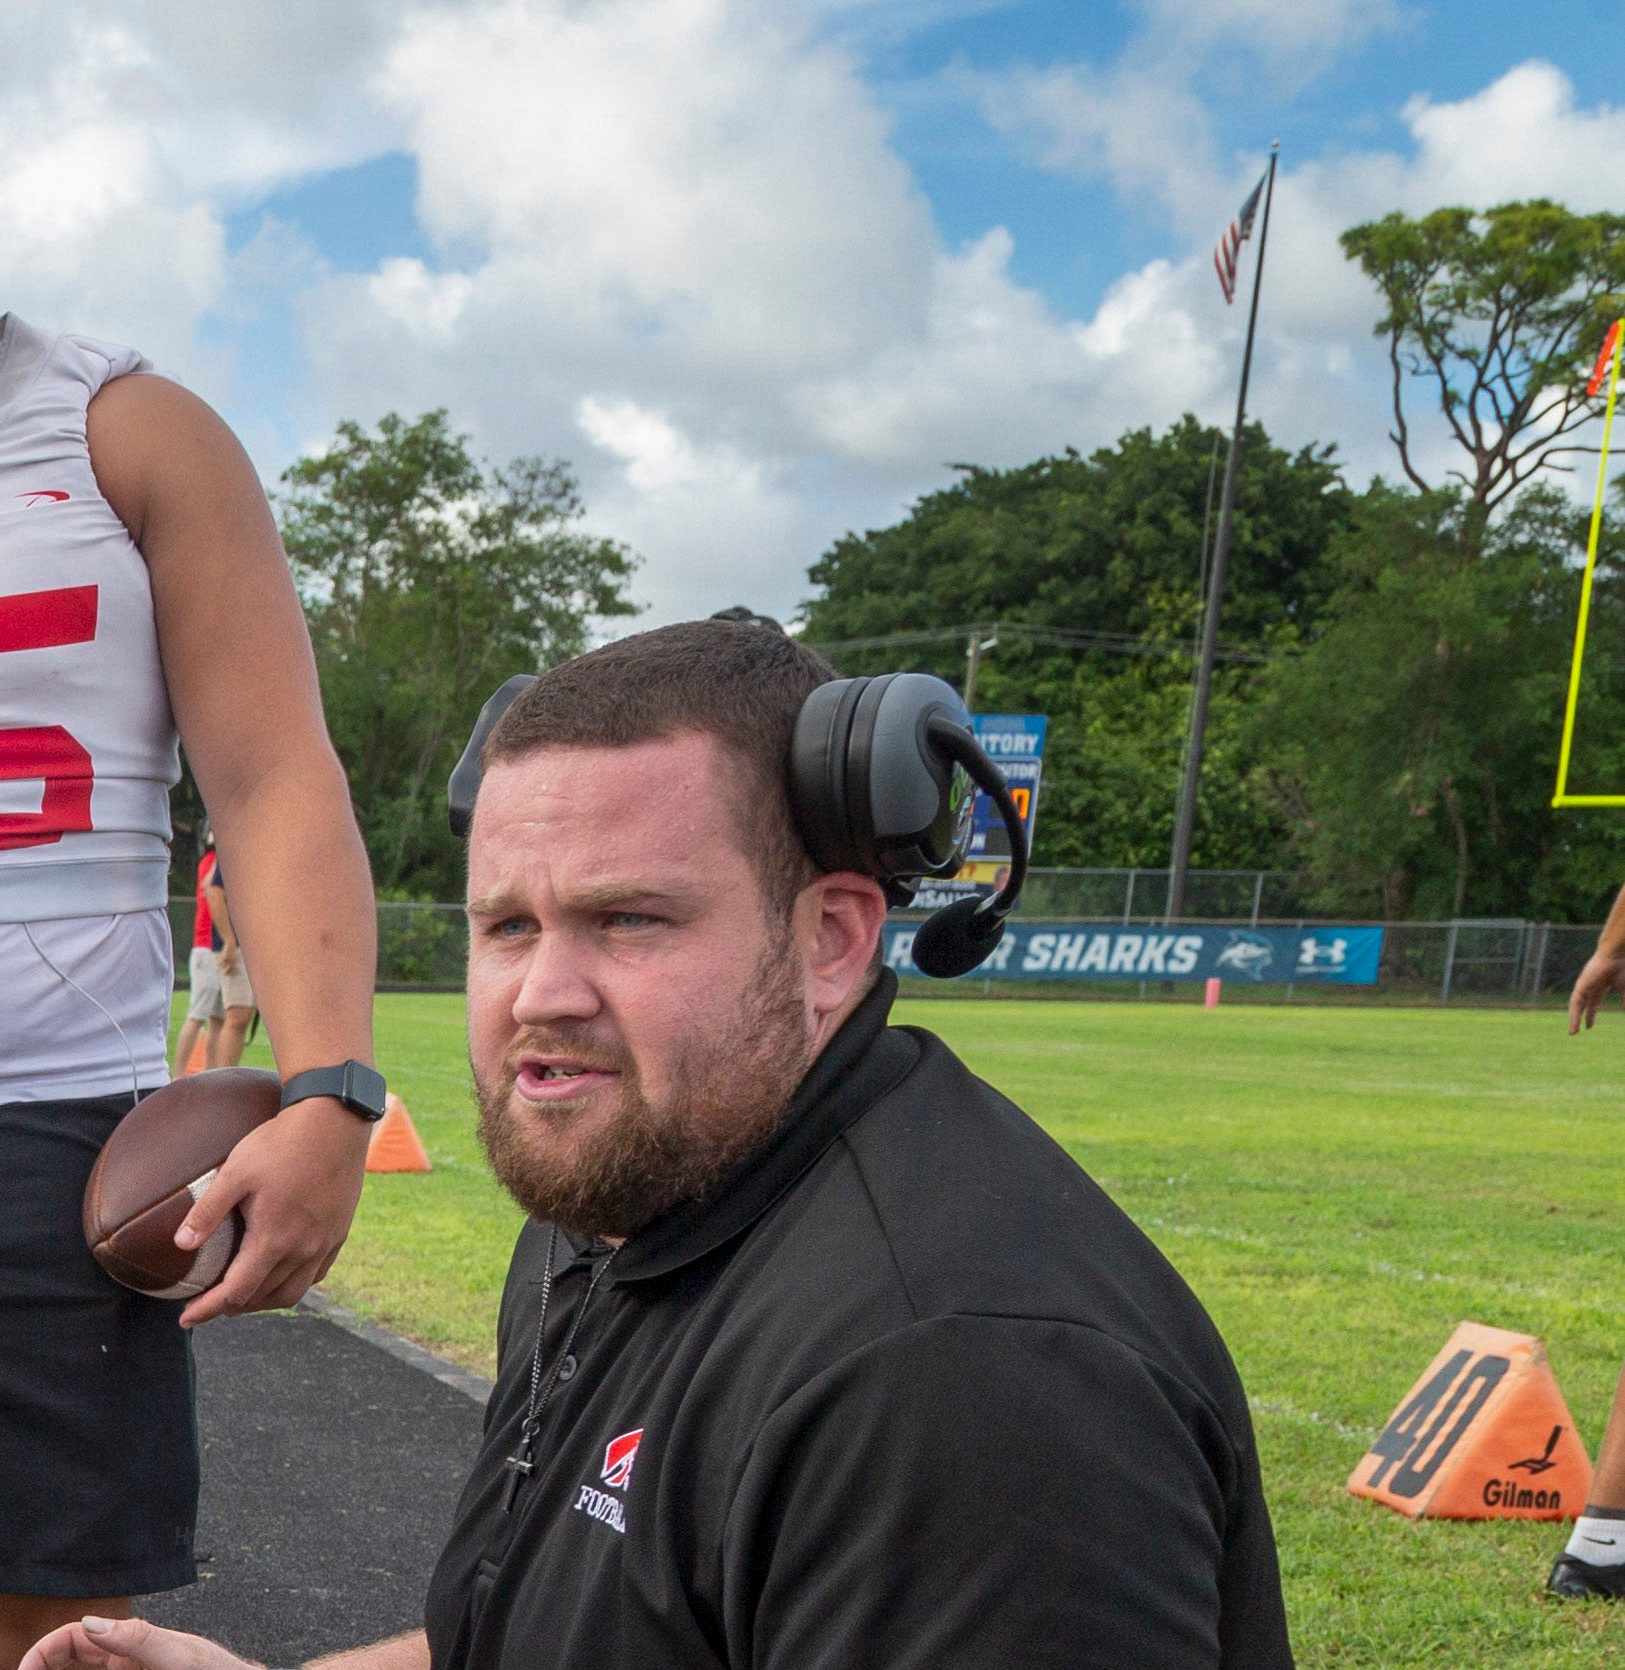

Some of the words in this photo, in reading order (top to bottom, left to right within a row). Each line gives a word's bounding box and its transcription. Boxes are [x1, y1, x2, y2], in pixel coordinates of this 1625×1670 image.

[1023, 933, 1203, 974] SHARKS
[1367, 1349, 1511, 1499] 40
[1483, 1478, 1562, 1510] Gilman
